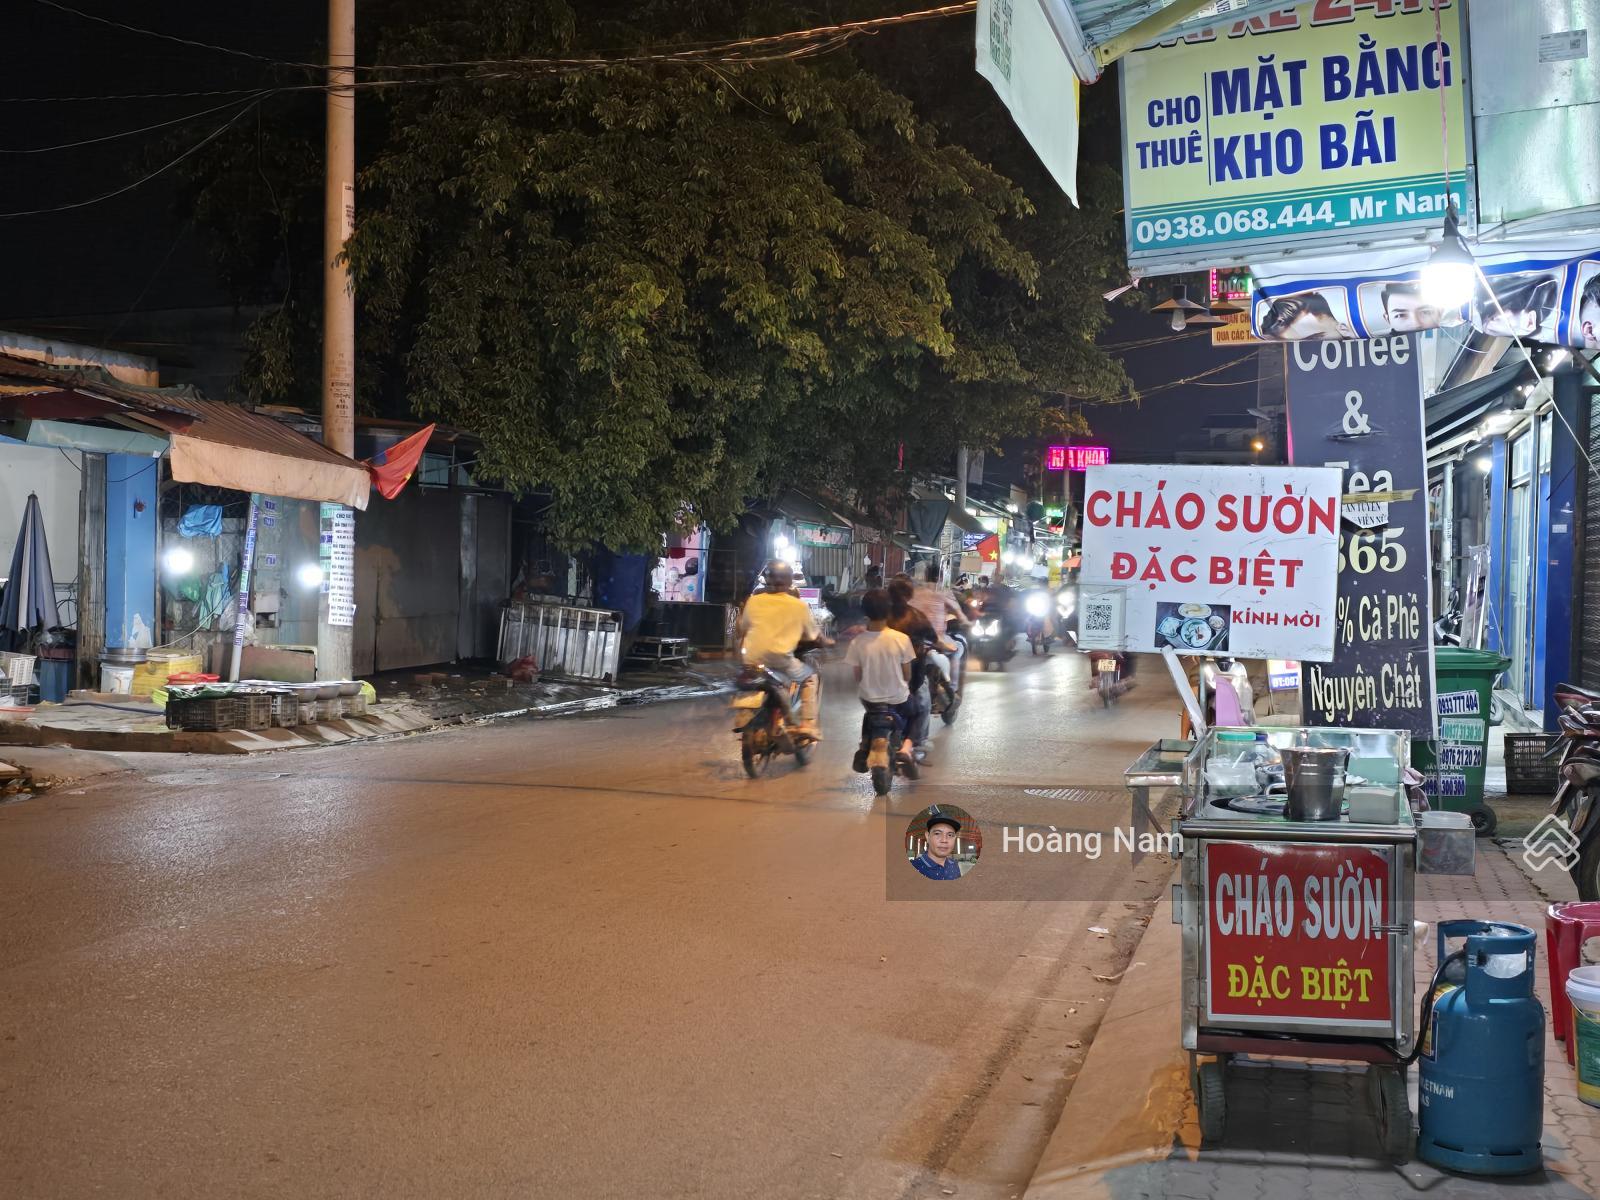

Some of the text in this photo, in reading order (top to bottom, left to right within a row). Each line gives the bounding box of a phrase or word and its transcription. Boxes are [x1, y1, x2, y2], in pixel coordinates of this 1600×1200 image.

[1210, 33, 1452, 121] MẶT BẰNG
[1147, 95, 1201, 128] CHO
[1136, 130, 1203, 170] THUÊ
[1213, 109, 1397, 183] KHO BÃI
[1396, 189, 1461, 216] Nam
[1342, 390, 1371, 435] &
[1087, 480, 1336, 536] CHÁO SƯỜN
[1110, 546, 1304, 596] ĐẶC BIỆT
[1232, 608, 1321, 628] KÍNH MỜI
[1358, 594, 1382, 641] Cà
[1387, 593, 1420, 640] Phê
[1310, 652, 1423, 723] Nguyên Chất
[1453, 695, 1466, 713] 777
[1216, 858, 1382, 940] CHÁO SƯỜN
[1228, 955, 1373, 1010] ĐẶC BIỆT
